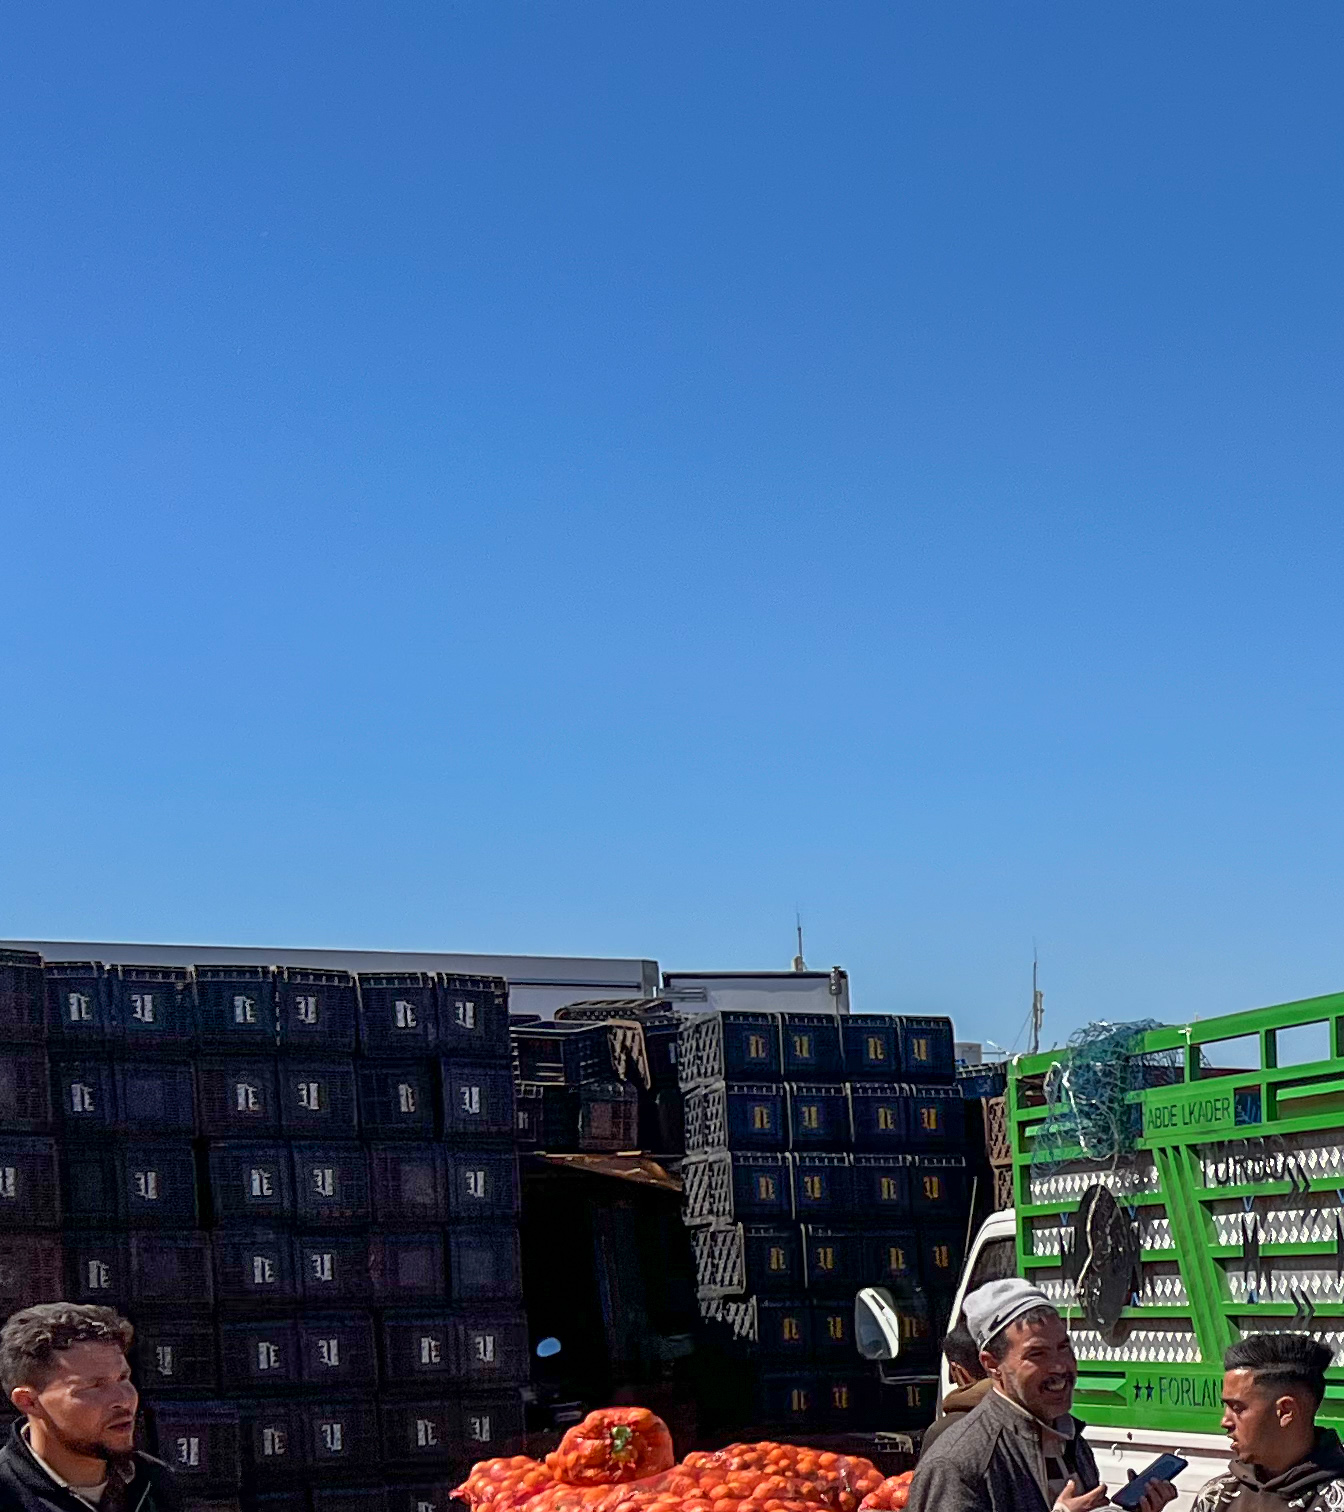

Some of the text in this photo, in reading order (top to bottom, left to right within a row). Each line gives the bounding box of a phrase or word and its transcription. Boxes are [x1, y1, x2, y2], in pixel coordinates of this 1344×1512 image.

[1147, 1096, 1232, 1130] ABDE LKADER
[1158, 1376, 1225, 1409] FORLAN
